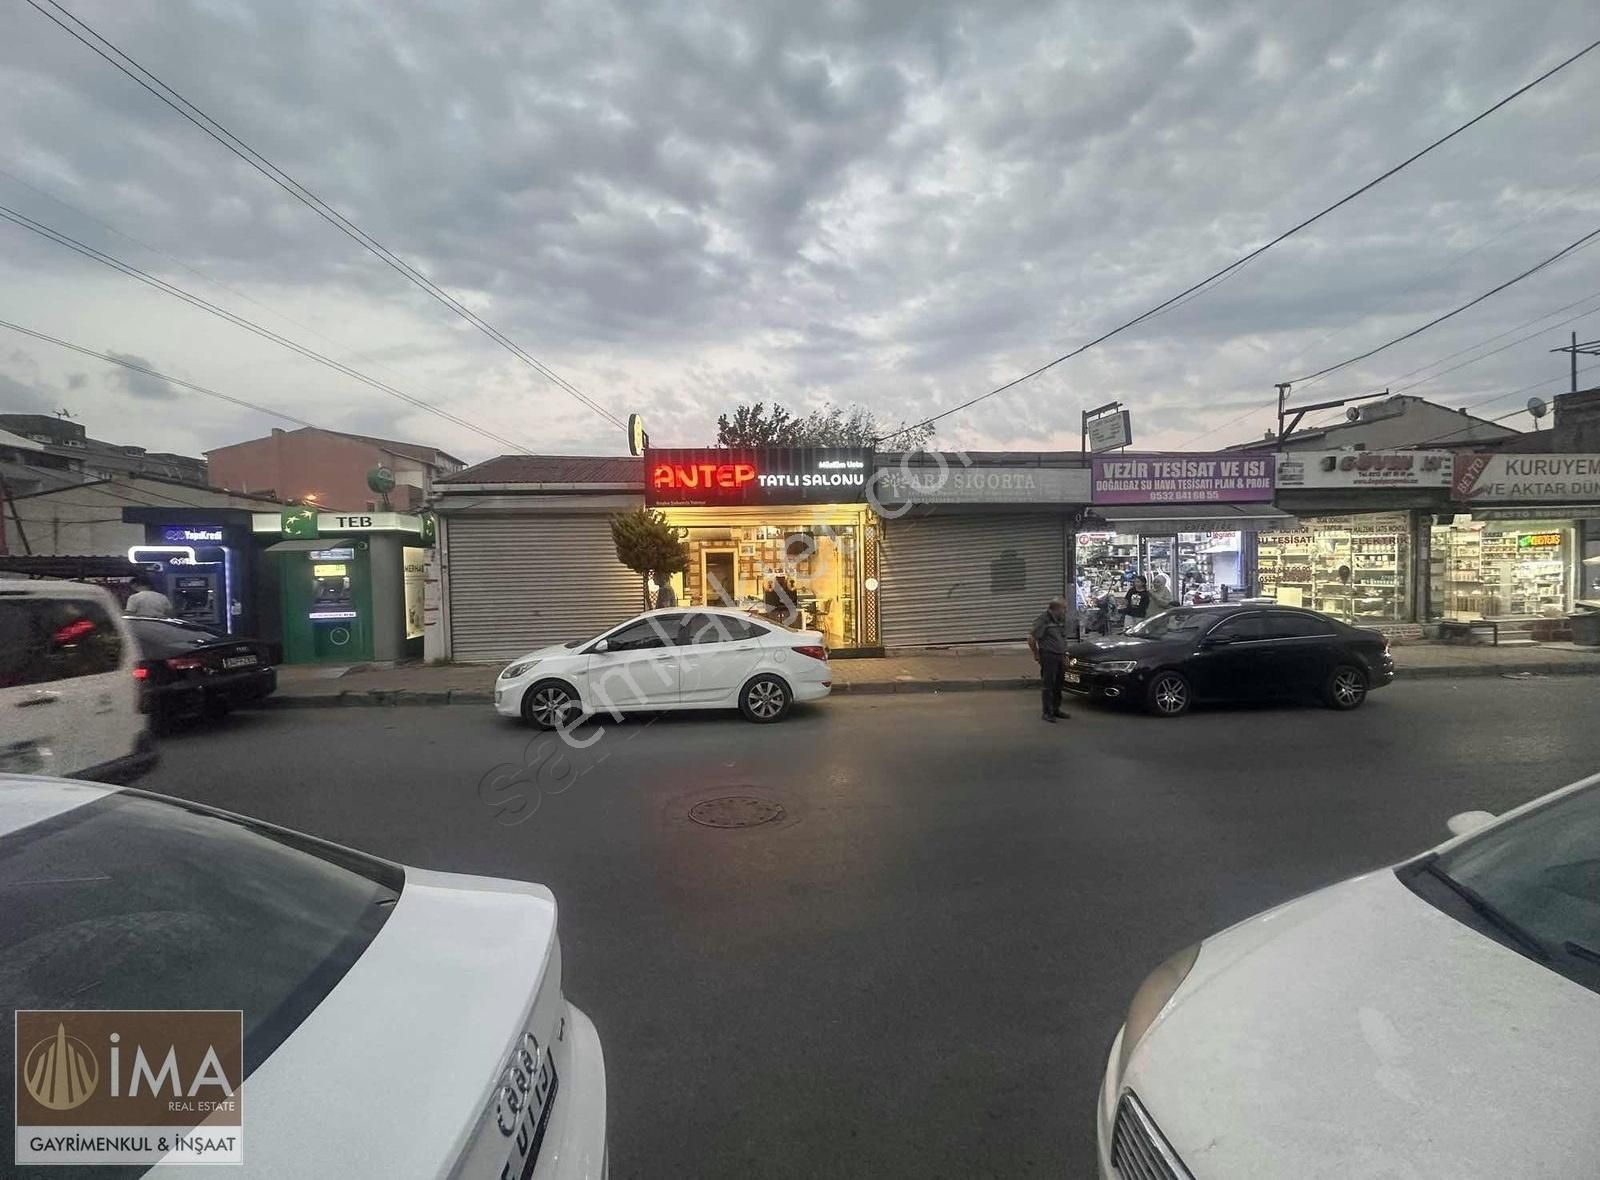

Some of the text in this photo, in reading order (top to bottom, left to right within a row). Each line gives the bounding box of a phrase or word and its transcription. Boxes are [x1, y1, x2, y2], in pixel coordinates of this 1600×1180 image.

[655, 464, 755, 488] ANTEP
[1103, 460, 1148, 479] VEZİR
[1153, 460, 1216, 478] TESİSAT
[1220, 461, 1240, 477] VE
[1243, 461, 1265, 476] ISI
[758, 474, 864, 487] TATLI SALONU
[1096, 478, 1270, 491] DOĞALGAZ SU HAVA TESİSATI PLAN & PROJE
[1511, 482, 1566, 494] AKTAR
[336, 516, 373, 528] TEB
[1272, 536, 1315, 544] TESİSATI
